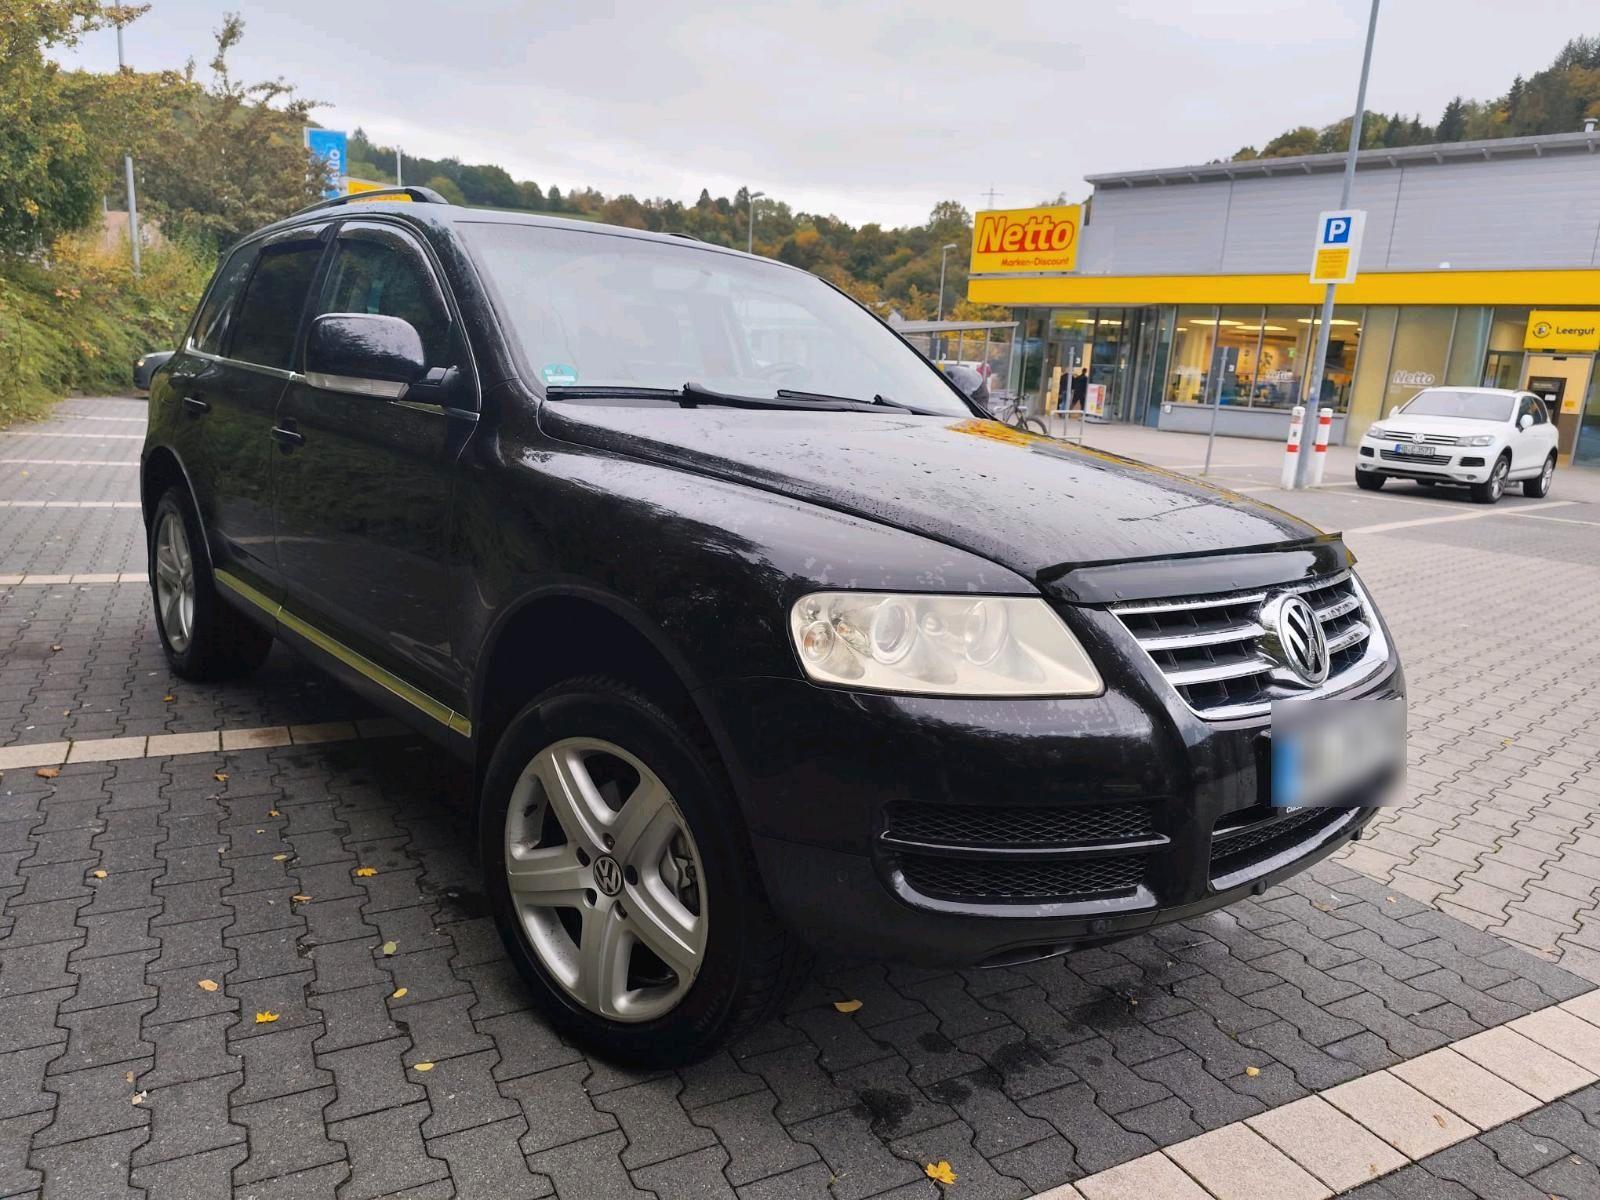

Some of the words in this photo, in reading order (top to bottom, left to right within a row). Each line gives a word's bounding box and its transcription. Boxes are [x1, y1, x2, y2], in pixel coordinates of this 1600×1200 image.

[977, 215, 1075, 253] Netto
[1328, 220, 1347, 242] P
[1001, 257, 1070, 266] Marken-Discount
[1556, 326, 1595, 337] Leergut
[1392, 369, 1435, 385] Netto
